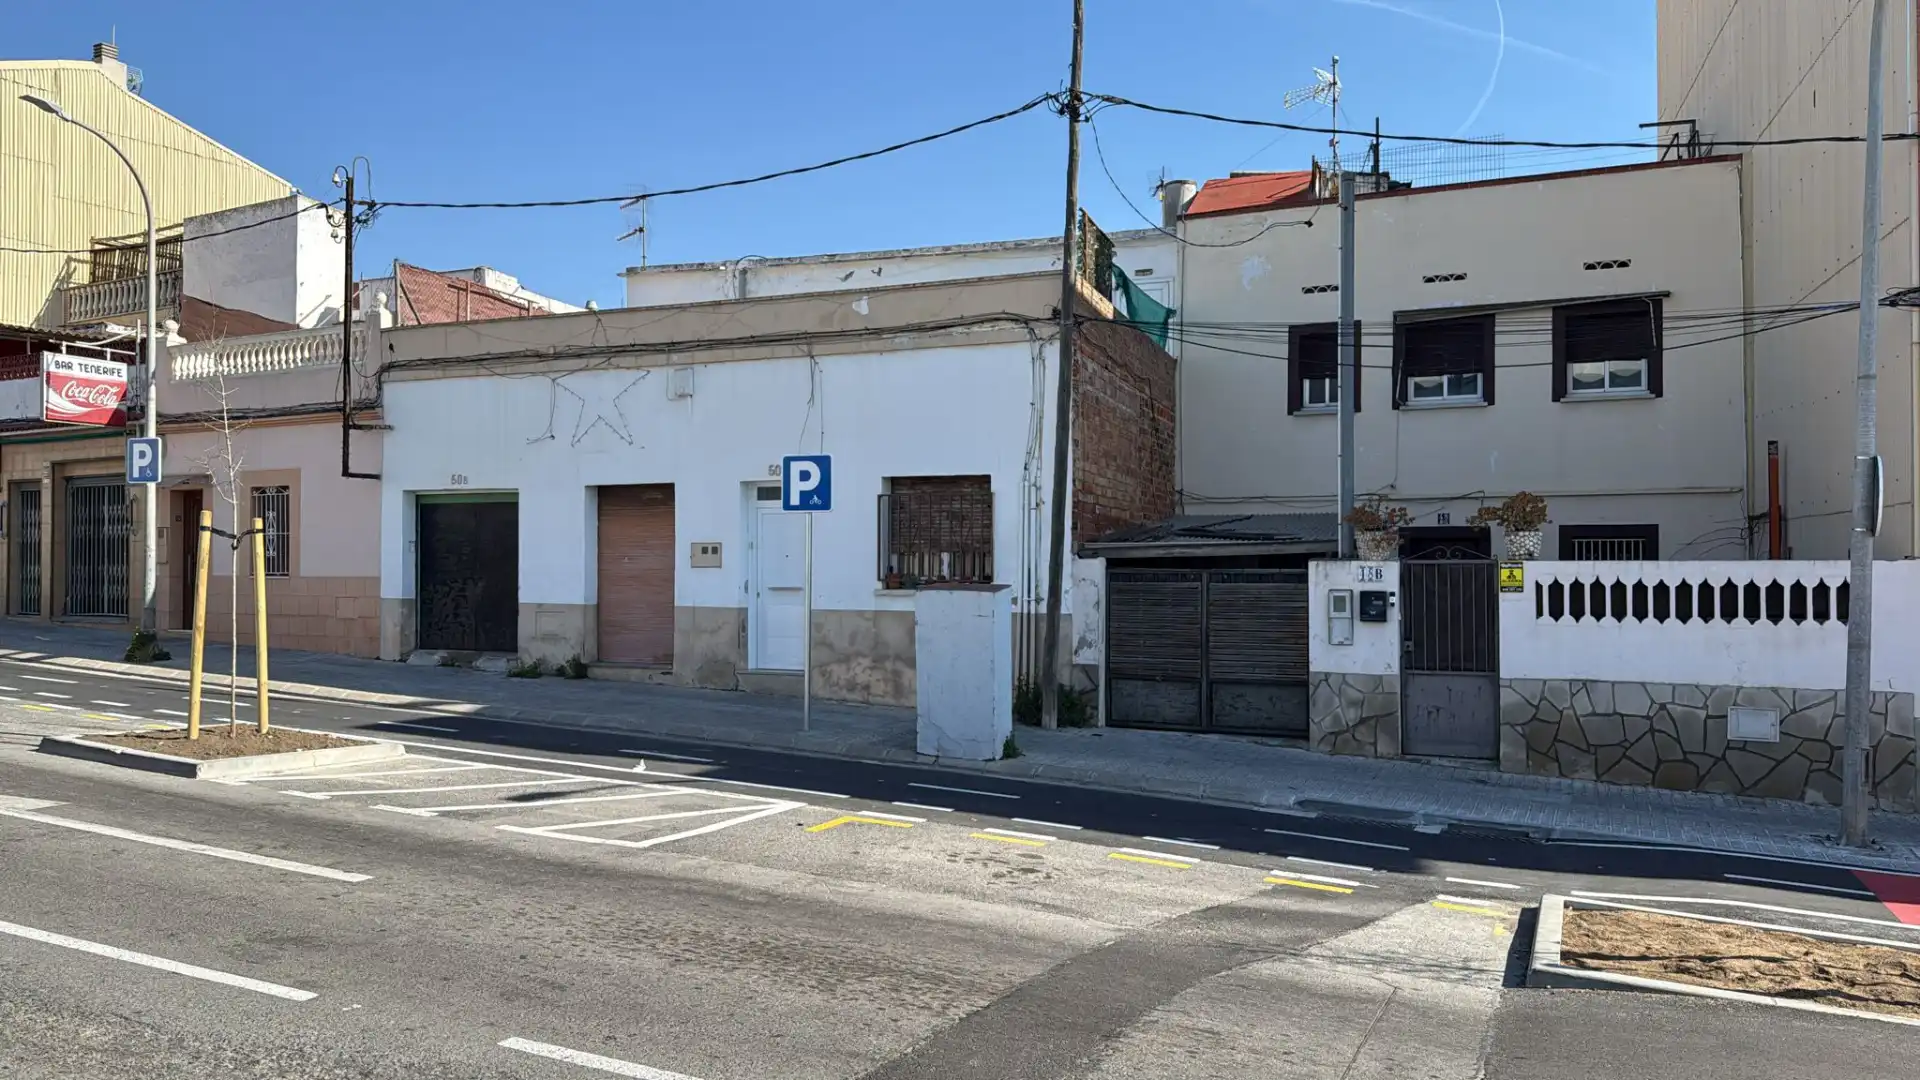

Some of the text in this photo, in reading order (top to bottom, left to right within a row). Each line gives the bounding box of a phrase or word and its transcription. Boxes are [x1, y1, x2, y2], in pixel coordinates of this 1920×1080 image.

[54, 360, 123, 378] BAR TENERIFE
[61, 380, 120, 407] Coca-Cola
[132, 443, 152, 478] P
[789, 460, 821, 506] P
